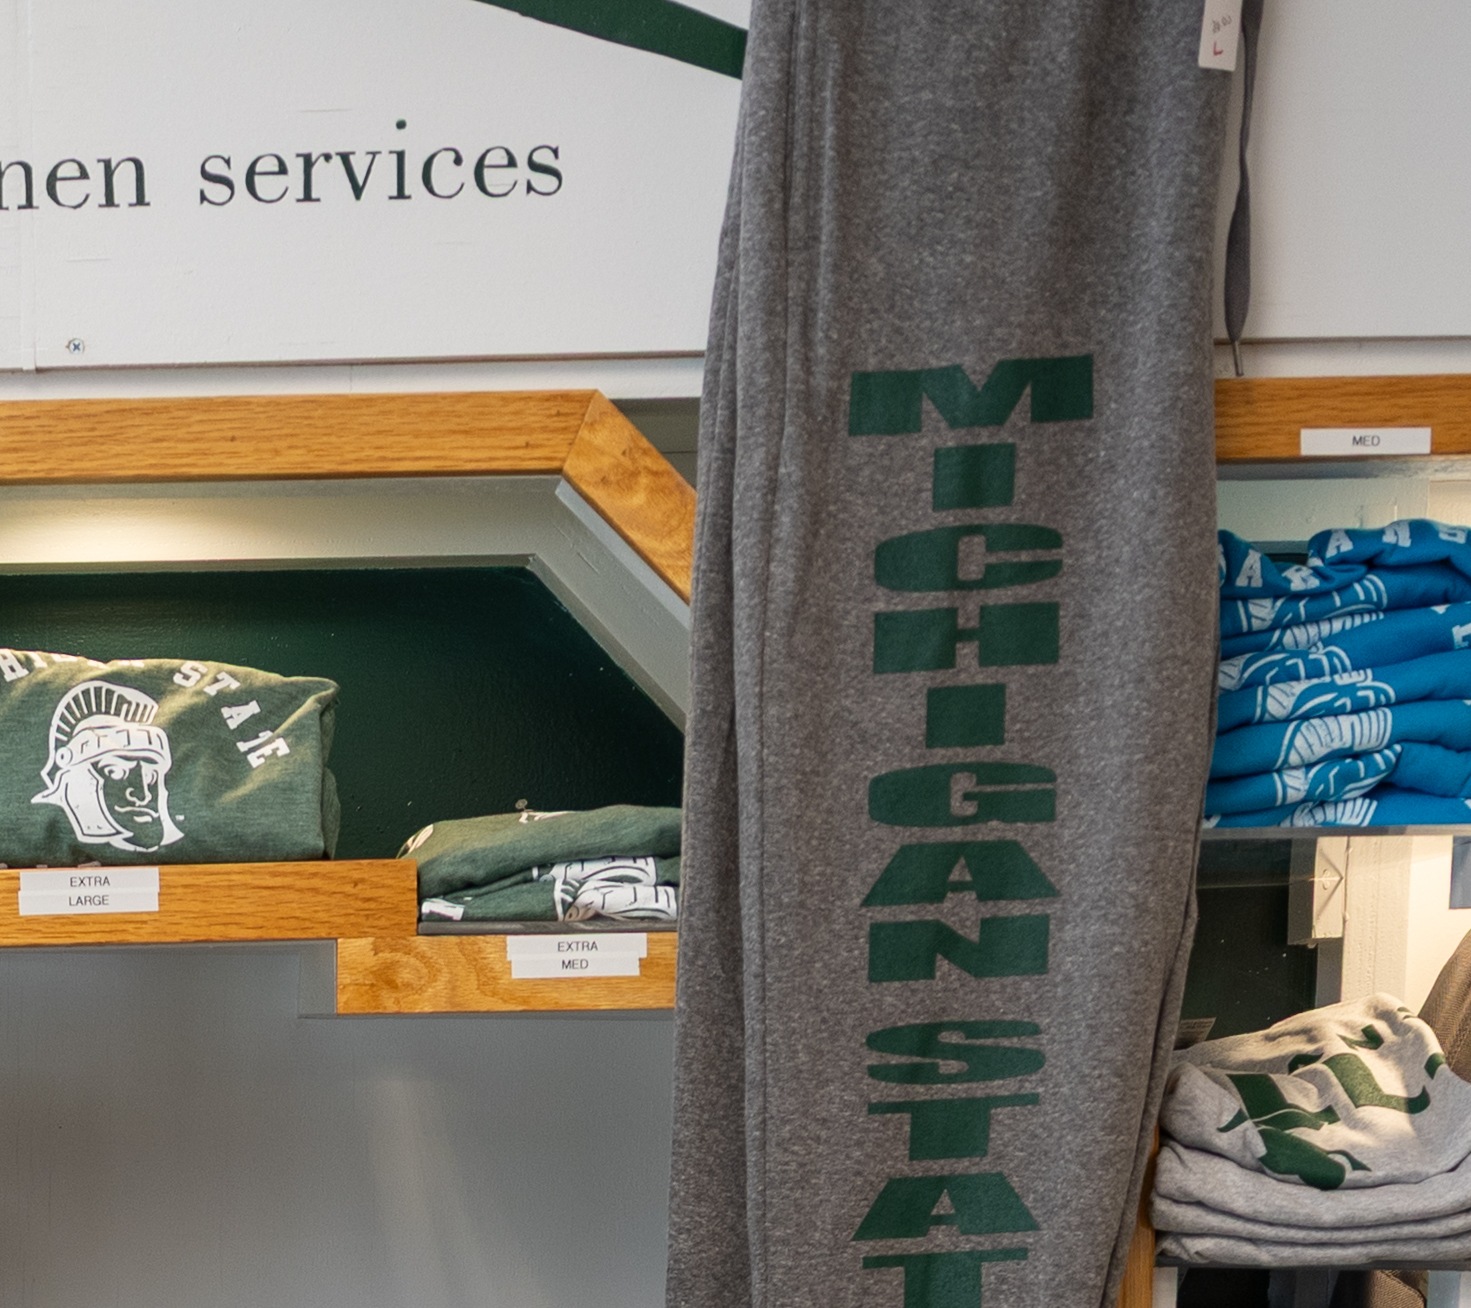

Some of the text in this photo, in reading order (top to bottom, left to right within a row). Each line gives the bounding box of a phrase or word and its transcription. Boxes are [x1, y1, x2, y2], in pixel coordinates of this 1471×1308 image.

[199, 119, 563, 207] services
[1352, 435, 1381, 447] MED
[848, 354, 1094, 983] MICHIGAN
[173, 660, 290, 768] STATE
[69, 875, 111, 888] EXTRA
[68, 894, 109, 907] LARGE
[557, 940, 599, 953] EXTRA
[561, 959, 589, 970] MED
